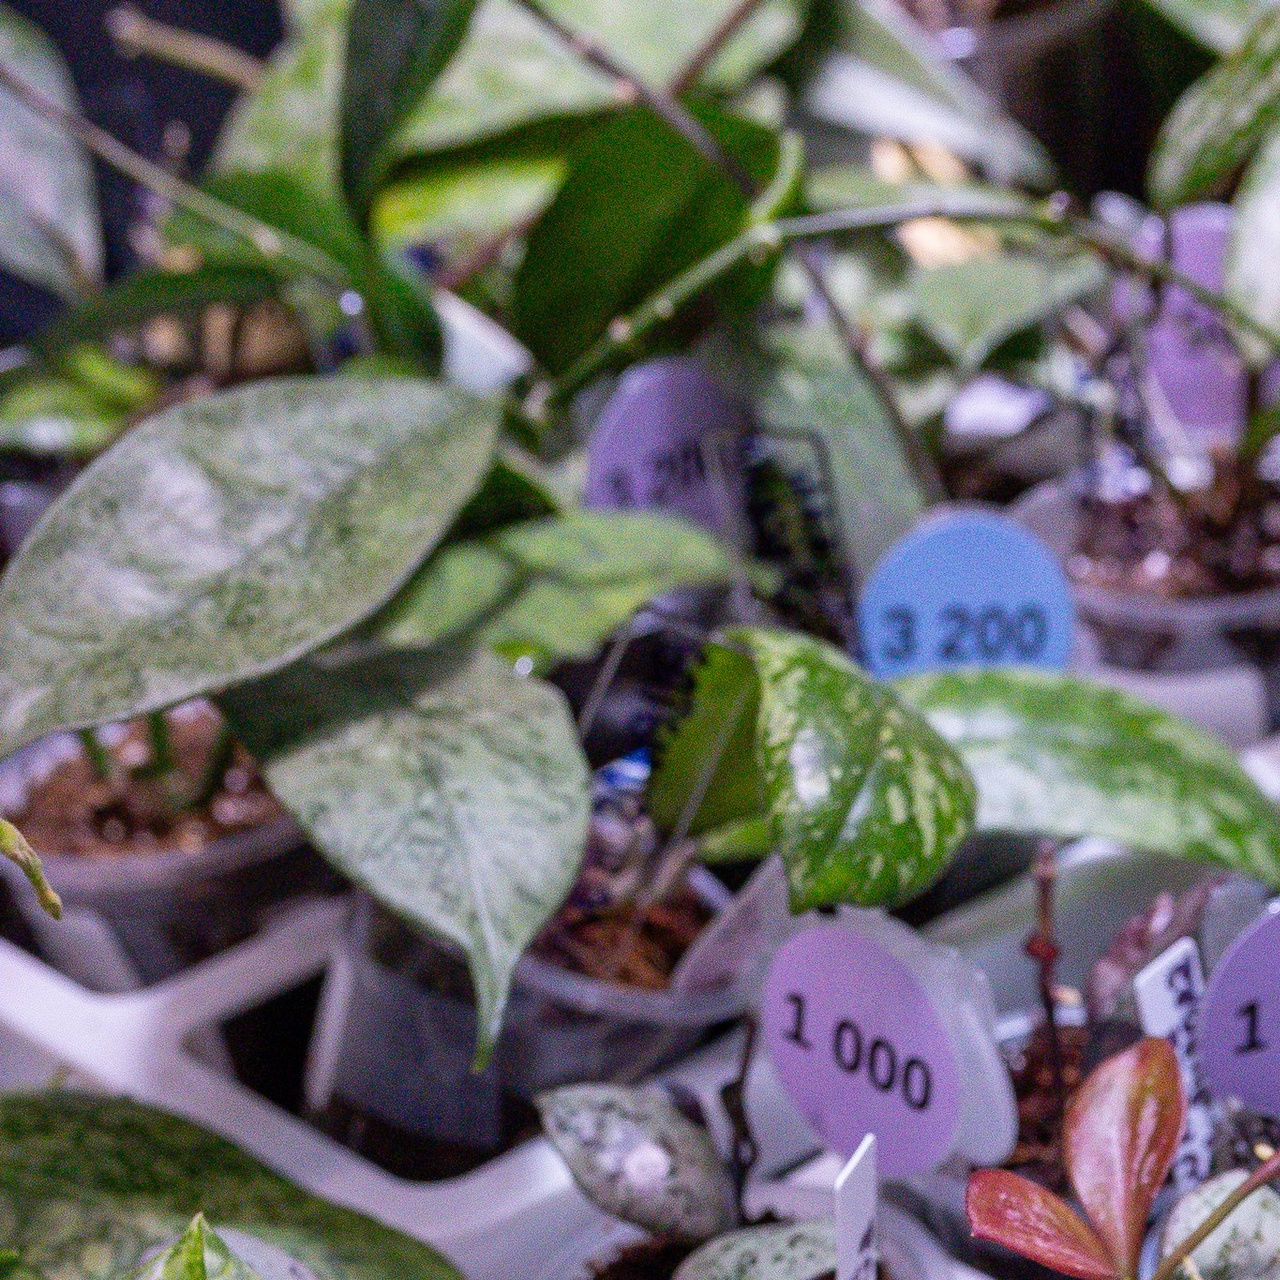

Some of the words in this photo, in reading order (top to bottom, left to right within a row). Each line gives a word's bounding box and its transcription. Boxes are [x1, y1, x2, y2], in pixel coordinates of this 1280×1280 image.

[881, 602, 918, 663] 3
[940, 602, 1050, 664] 200
[784, 992, 813, 1051] 1
[832, 1017, 935, 1111] 000
[1235, 1000, 1268, 1054] 1
